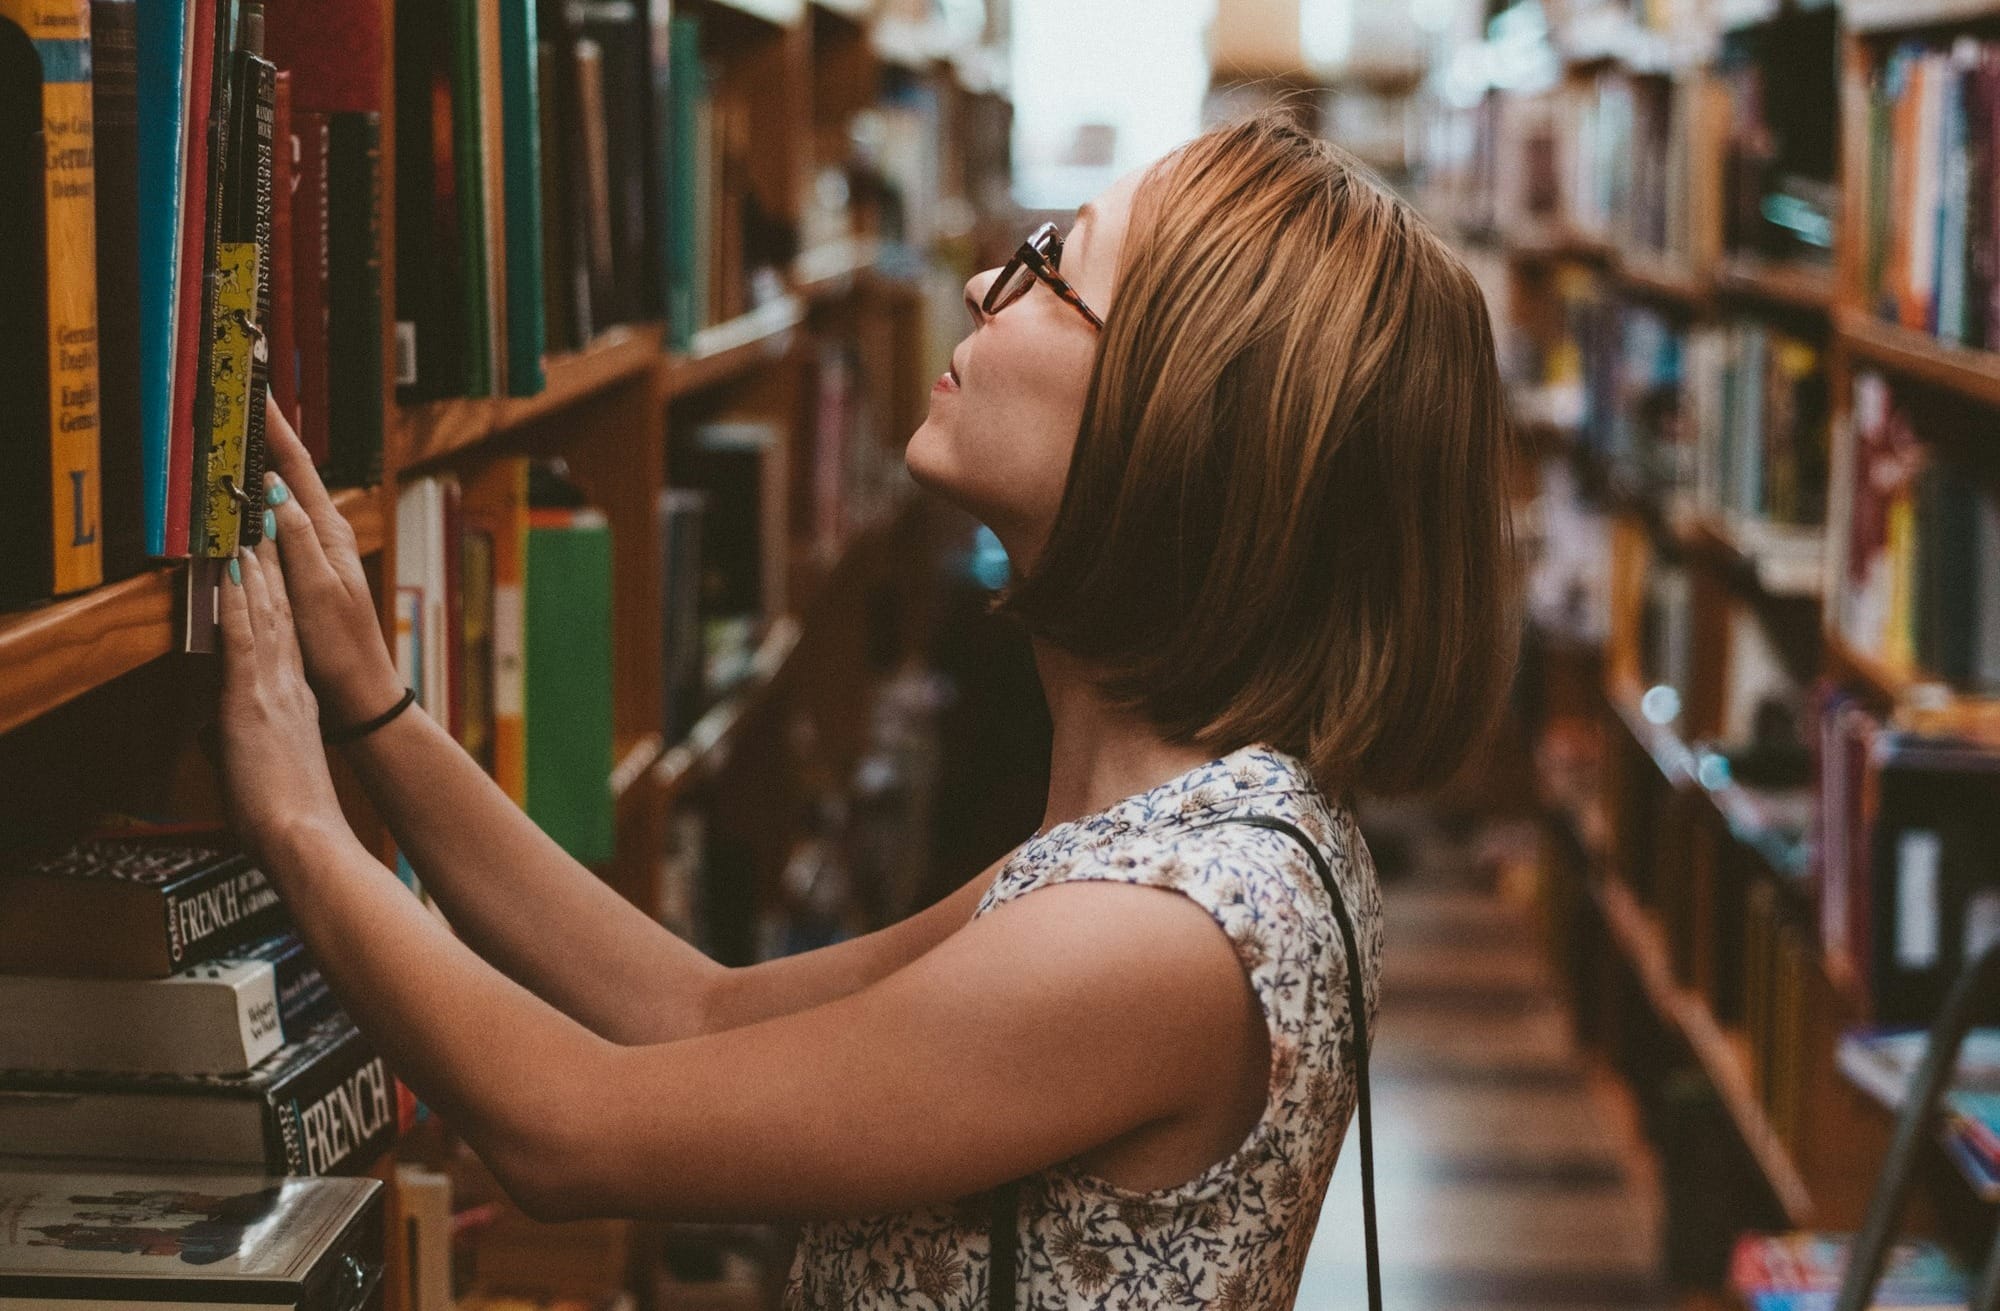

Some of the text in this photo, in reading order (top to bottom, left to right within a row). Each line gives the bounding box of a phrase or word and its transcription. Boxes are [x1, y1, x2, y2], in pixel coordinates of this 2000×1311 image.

[262, 145, 272, 293] GERMAN-ENGLISH
[72, 471, 95, 547] L
[179, 878, 241, 946] FRENCH
[301, 1056, 391, 1178] FRENCH
